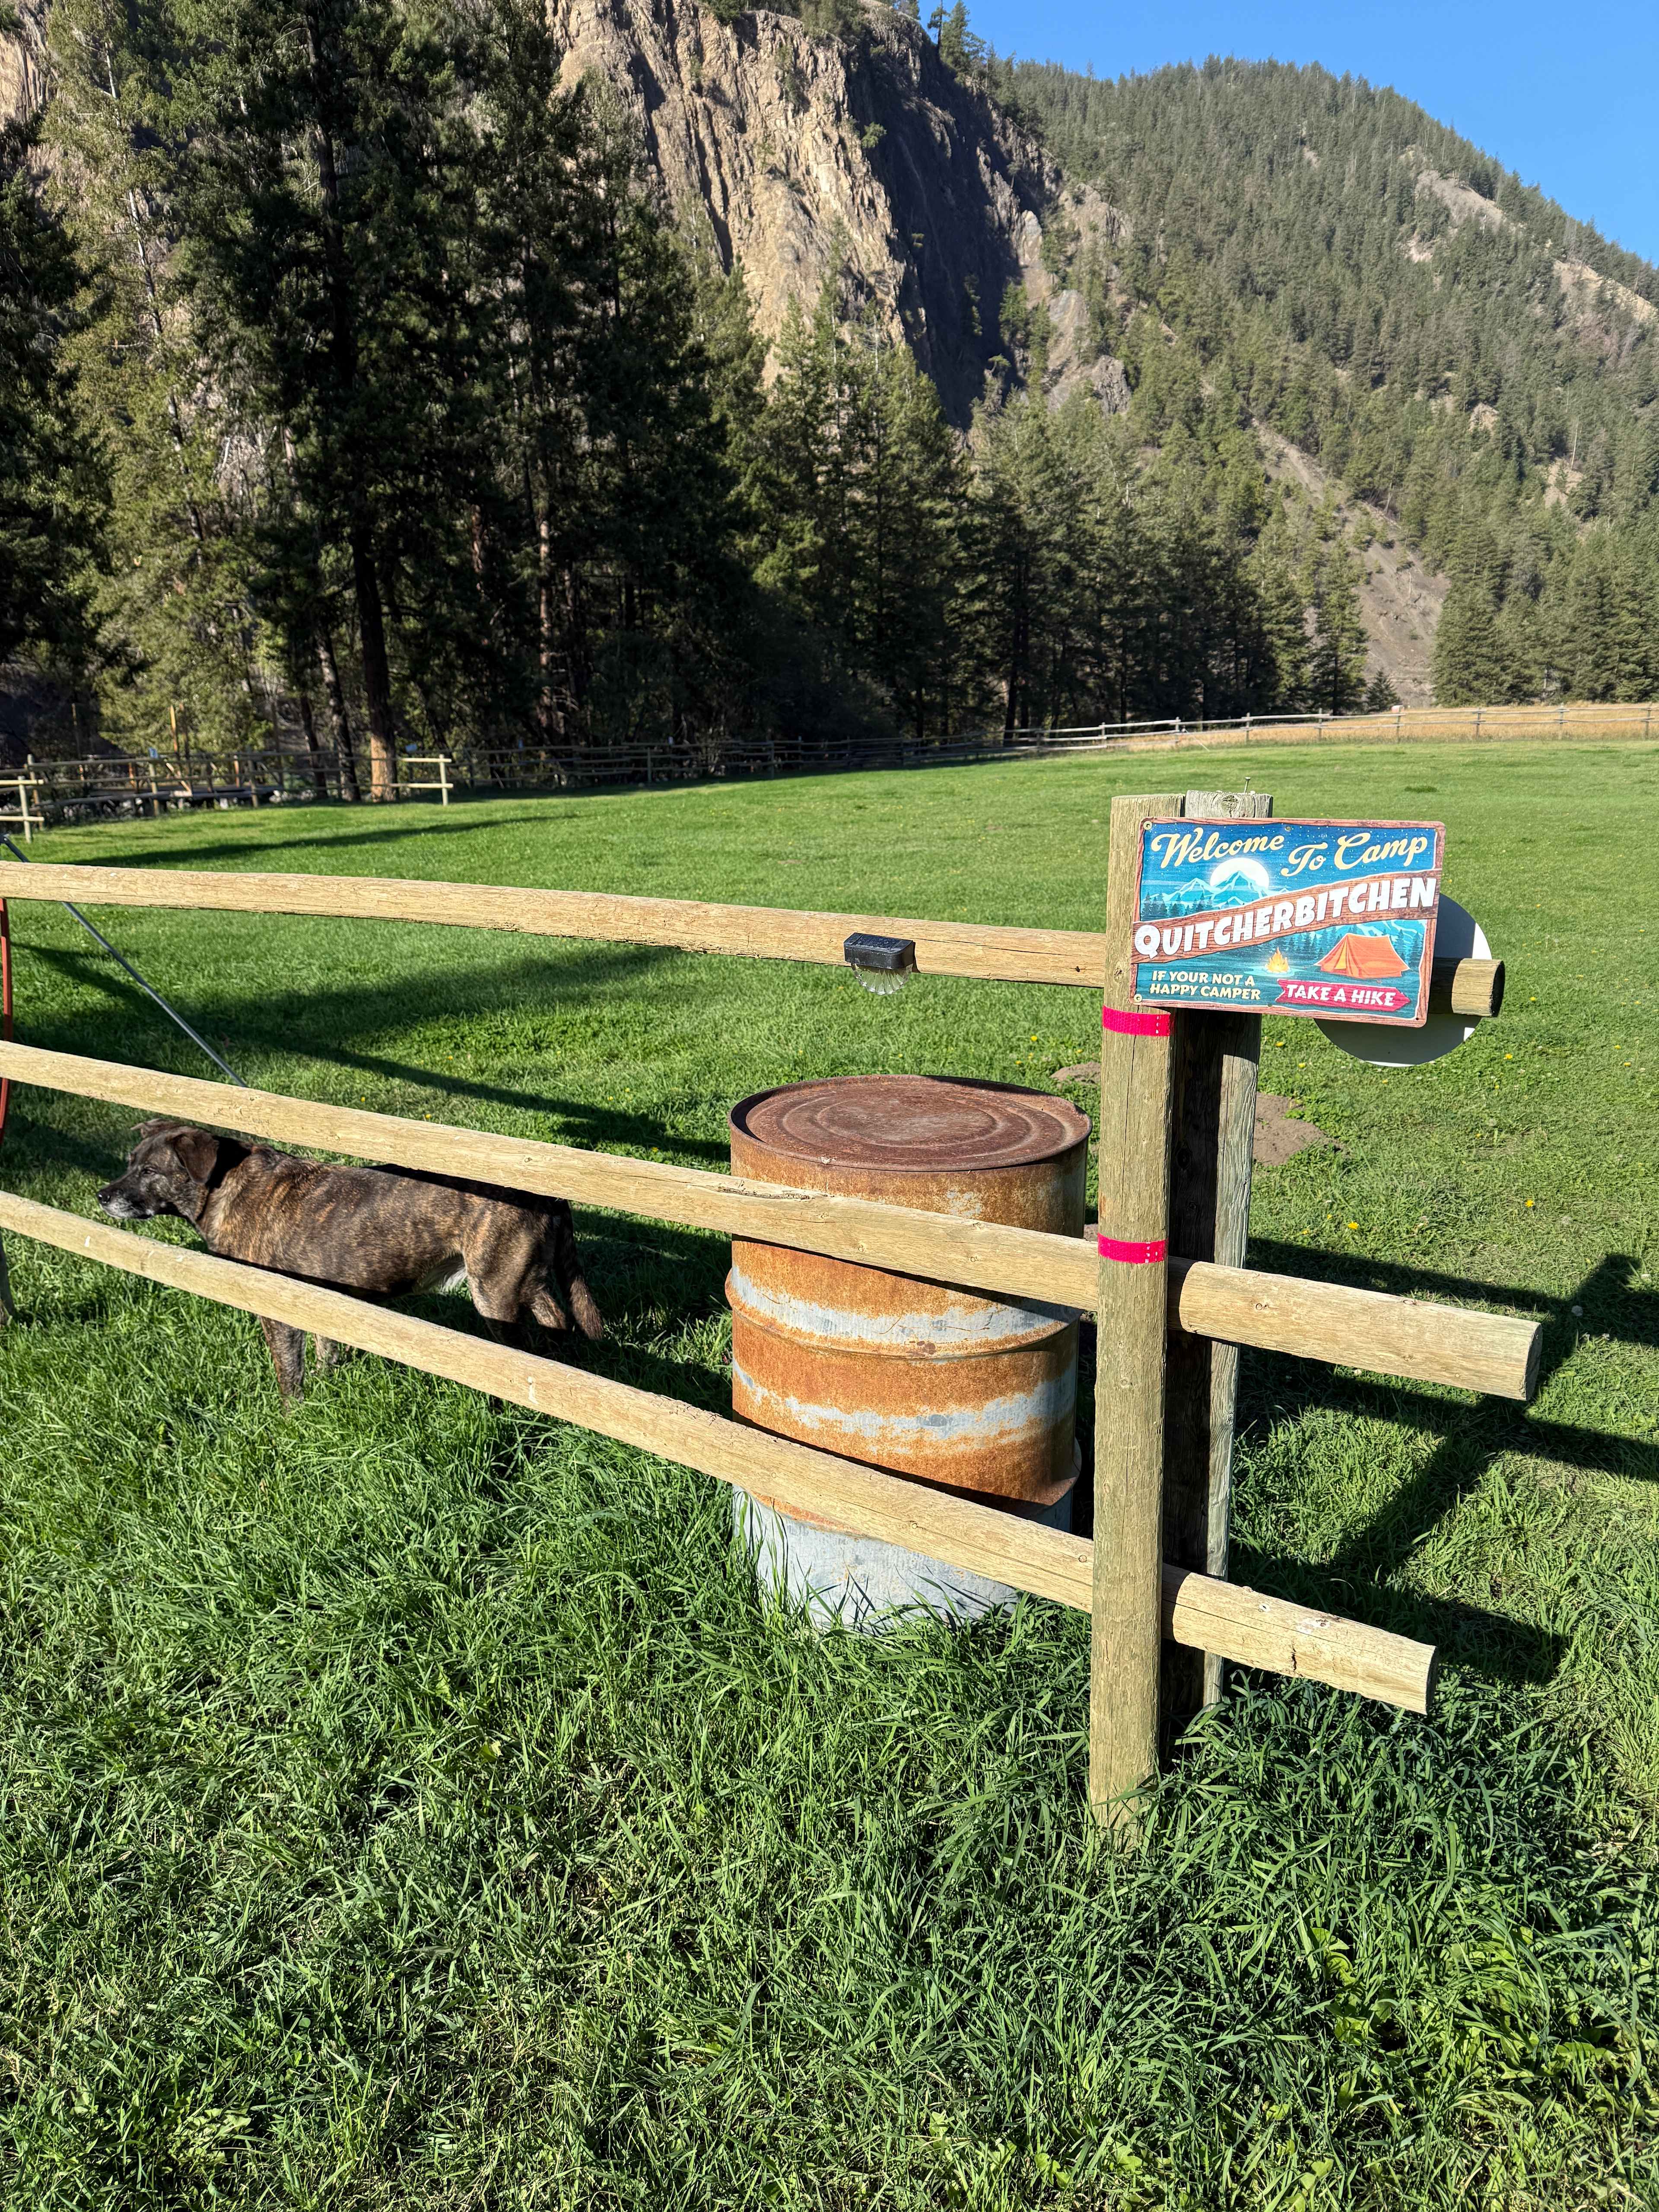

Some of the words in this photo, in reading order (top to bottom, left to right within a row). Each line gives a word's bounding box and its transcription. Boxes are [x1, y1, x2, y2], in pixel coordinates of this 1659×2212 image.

[1151, 827, 1284, 868] Welcome
[1281, 842, 1328, 877] To
[1335, 832, 1428, 870] Camp
[1135, 878, 1437, 959] QUITCHERBITCHEN
[1152, 970, 1167, 982] IF
[1169, 971, 1208, 984] YOUR
[1212, 973, 1242, 986] NOT
[1245, 976, 1256, 986] A
[1150, 984, 1198, 996] HAPPY
[1200, 986, 1261, 1001] CAMPER
[1287, 984, 1332, 1001] TAKE
[1334, 988, 1346, 1002] A
[1351, 989, 1396, 1006] HIKE
